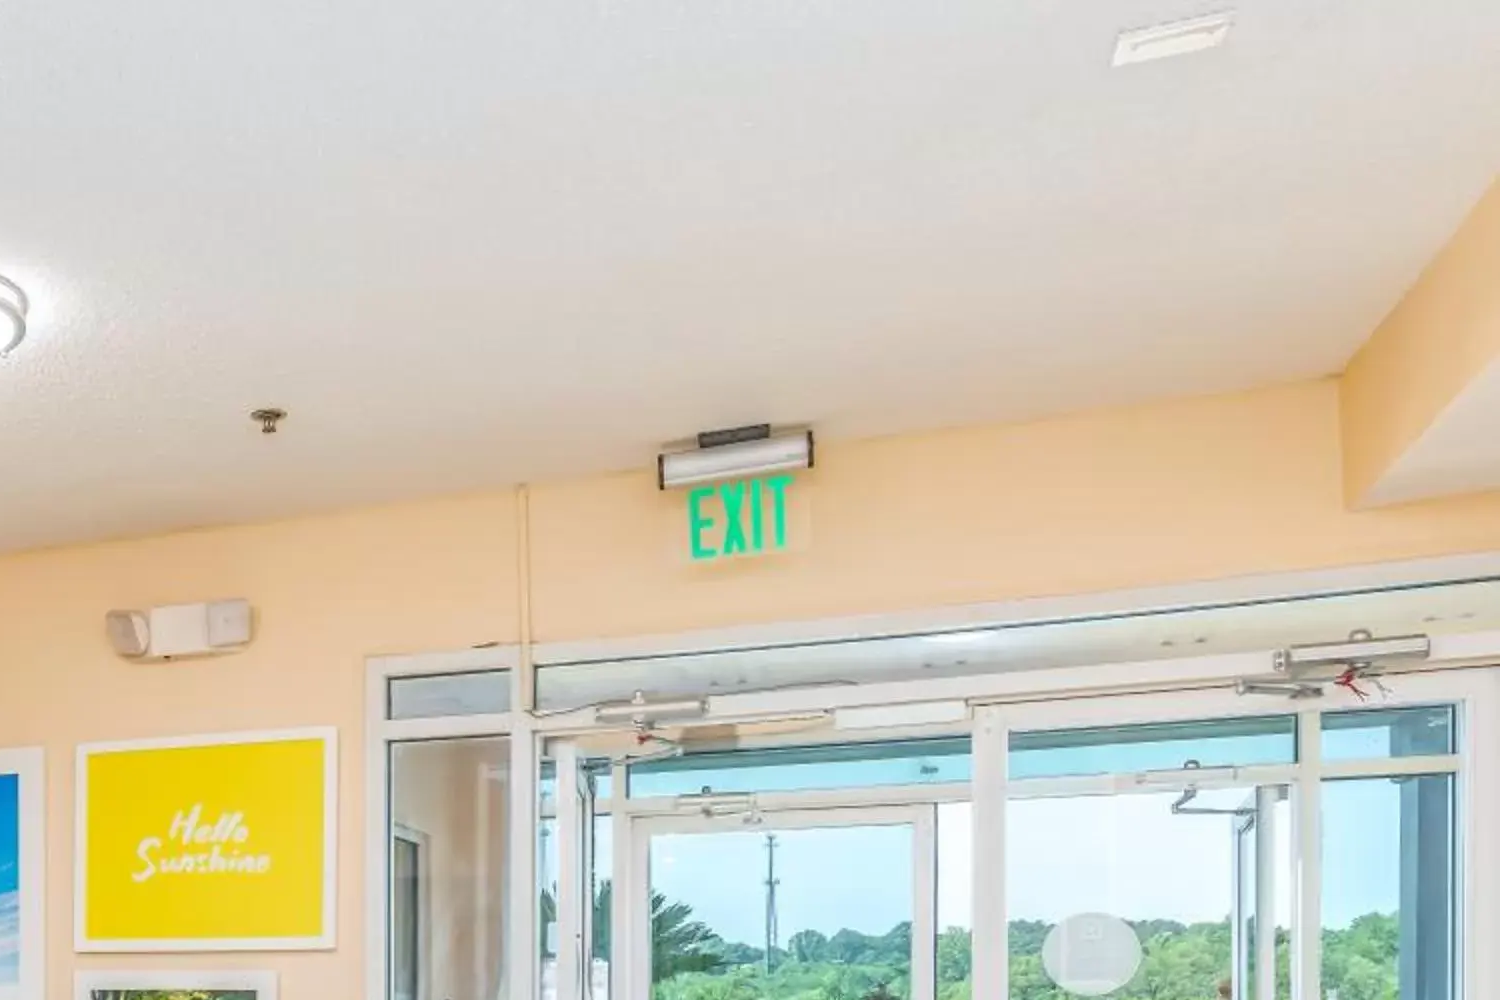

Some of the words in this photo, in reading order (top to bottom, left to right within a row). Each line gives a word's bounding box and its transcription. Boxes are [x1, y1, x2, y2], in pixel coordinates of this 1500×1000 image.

[688, 475, 794, 559] EXIT
[169, 801, 249, 845] Hello
[131, 836, 271, 883] Sunshine
